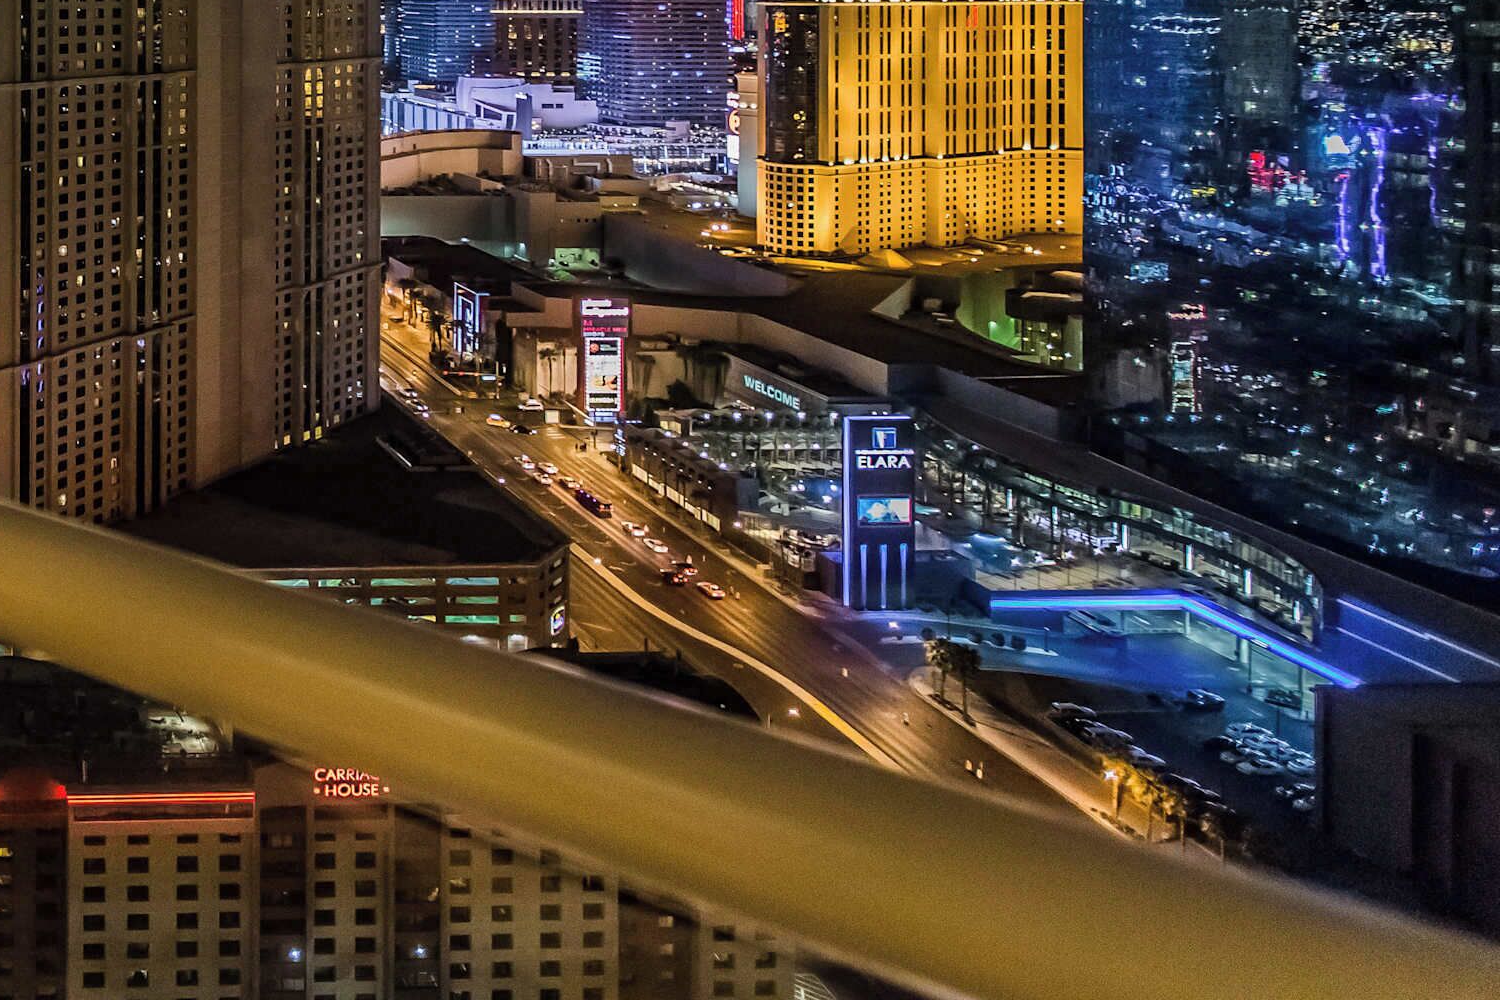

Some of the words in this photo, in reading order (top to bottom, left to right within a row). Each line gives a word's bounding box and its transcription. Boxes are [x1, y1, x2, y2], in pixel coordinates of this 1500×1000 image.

[743, 374, 801, 411] WELCOME
[857, 455, 911, 469] ELARA
[314, 767, 380, 782] CARRIA
[325, 783, 379, 797] HOUSE
